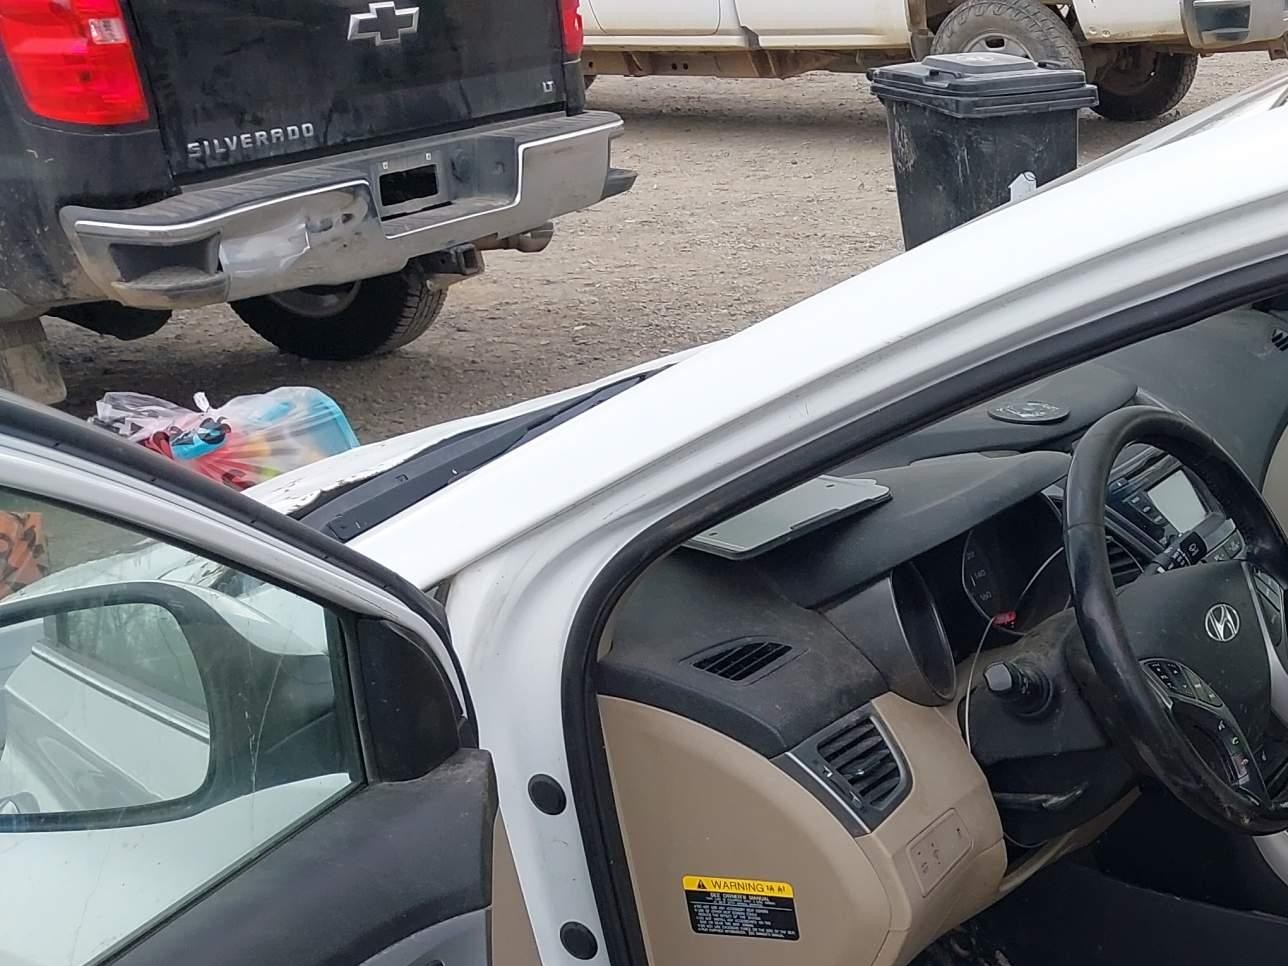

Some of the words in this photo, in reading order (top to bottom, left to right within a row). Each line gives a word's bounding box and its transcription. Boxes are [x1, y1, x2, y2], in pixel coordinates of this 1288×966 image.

[542, 80, 554, 92] LT
[186, 122, 314, 158] SILVERADO
[711, 880, 764, 892] WARNING
